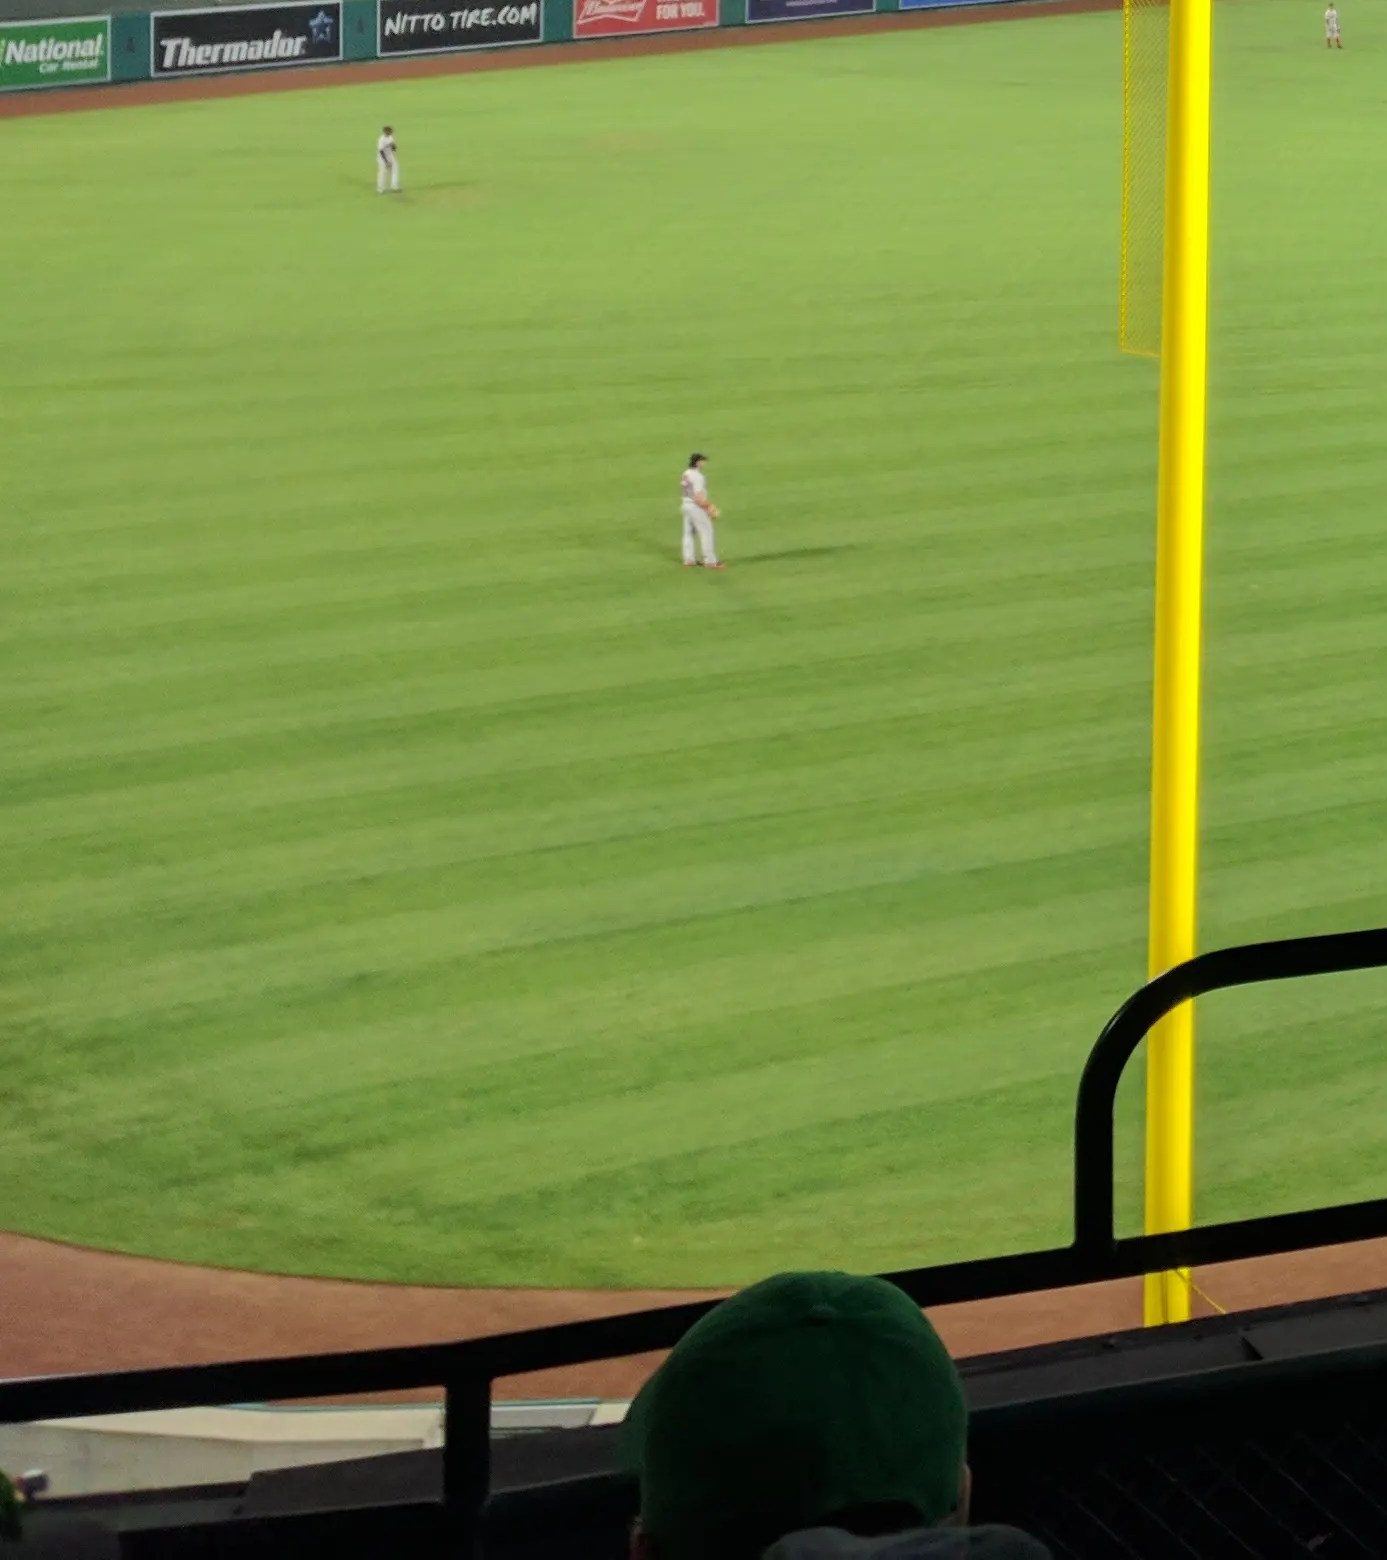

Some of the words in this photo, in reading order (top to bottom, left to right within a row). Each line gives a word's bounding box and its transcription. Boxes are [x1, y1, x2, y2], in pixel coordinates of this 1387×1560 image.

[384, 10, 447, 36] NITTO
[450, 1, 538, 29] TIRE.COM
[655, 3, 680, 20] FOR
[680, 2, 705, 18] YOU.
[5, 31, 104, 65] National
[161, 29, 308, 69] Thermador
